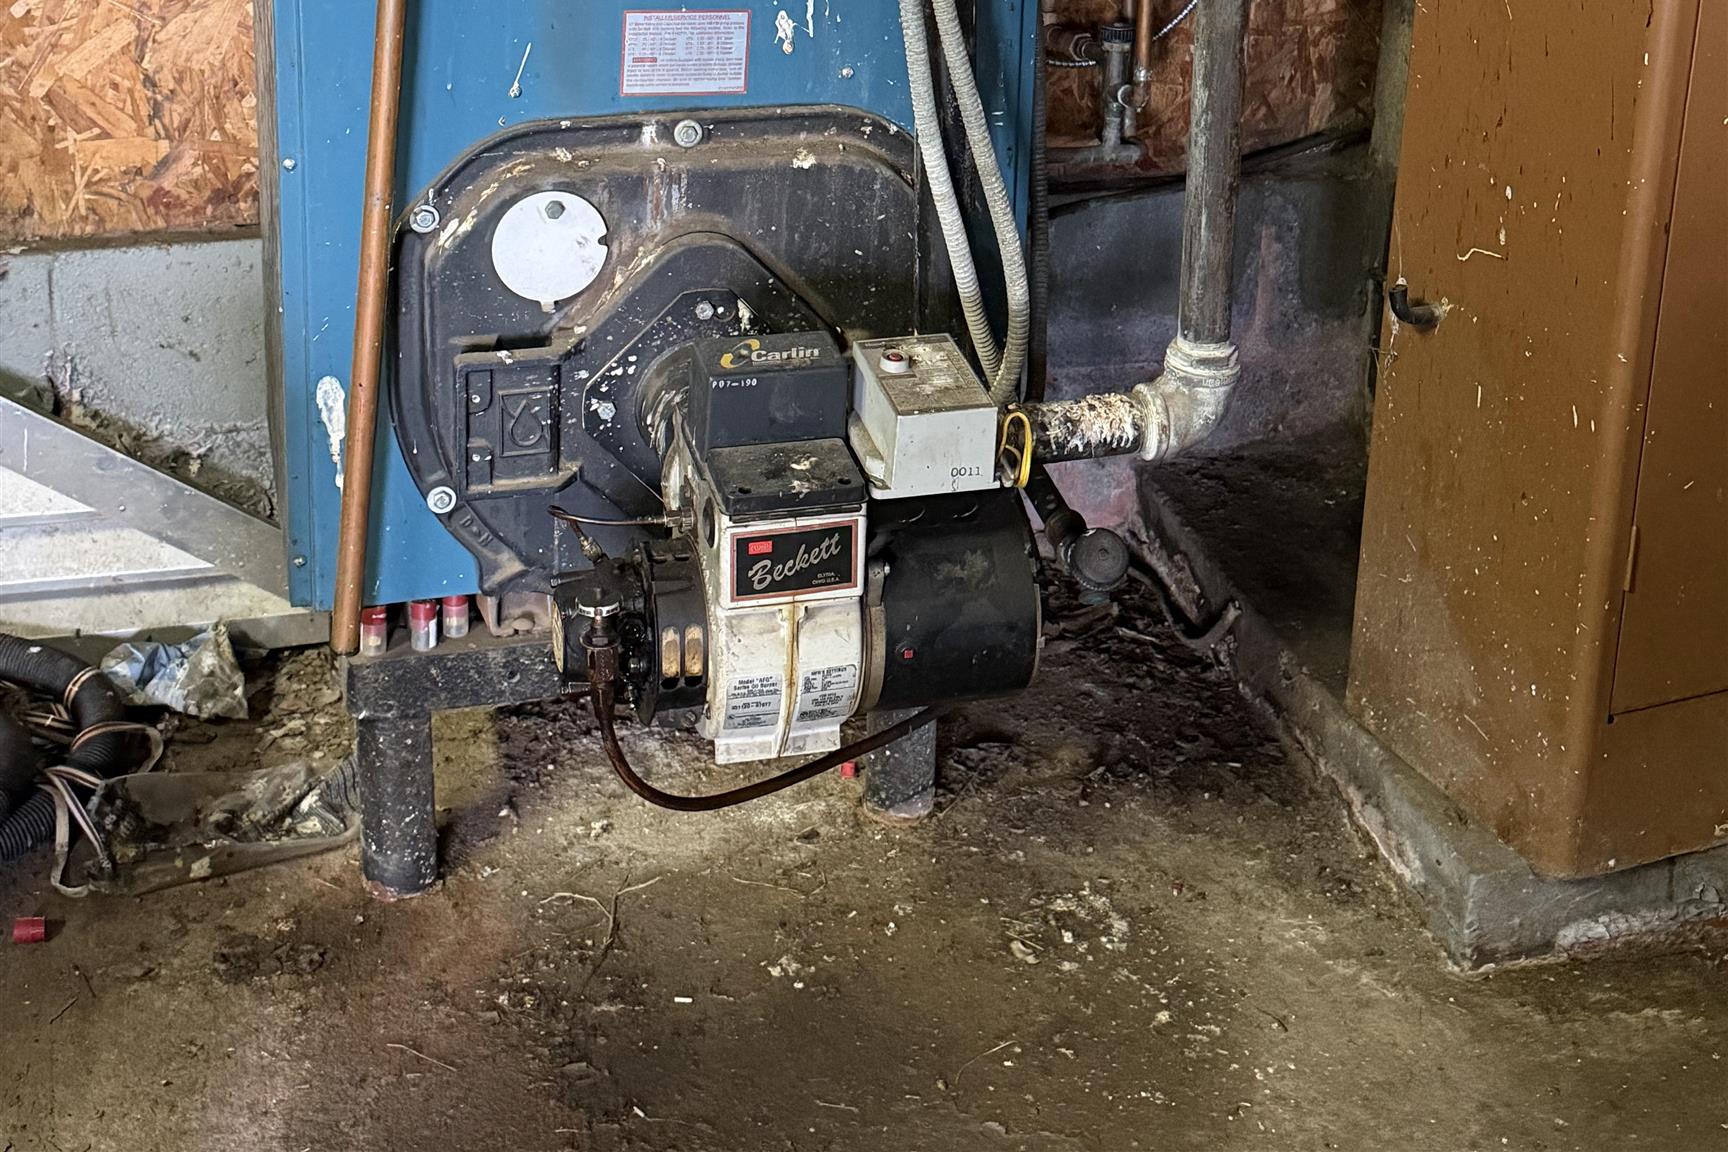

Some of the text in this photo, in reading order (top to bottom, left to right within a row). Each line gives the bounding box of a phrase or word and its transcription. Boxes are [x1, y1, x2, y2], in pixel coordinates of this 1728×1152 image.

[751, 347, 820, 362] Carlin
[950, 466, 981, 478] 0011
[747, 532, 842, 590] Beckett
